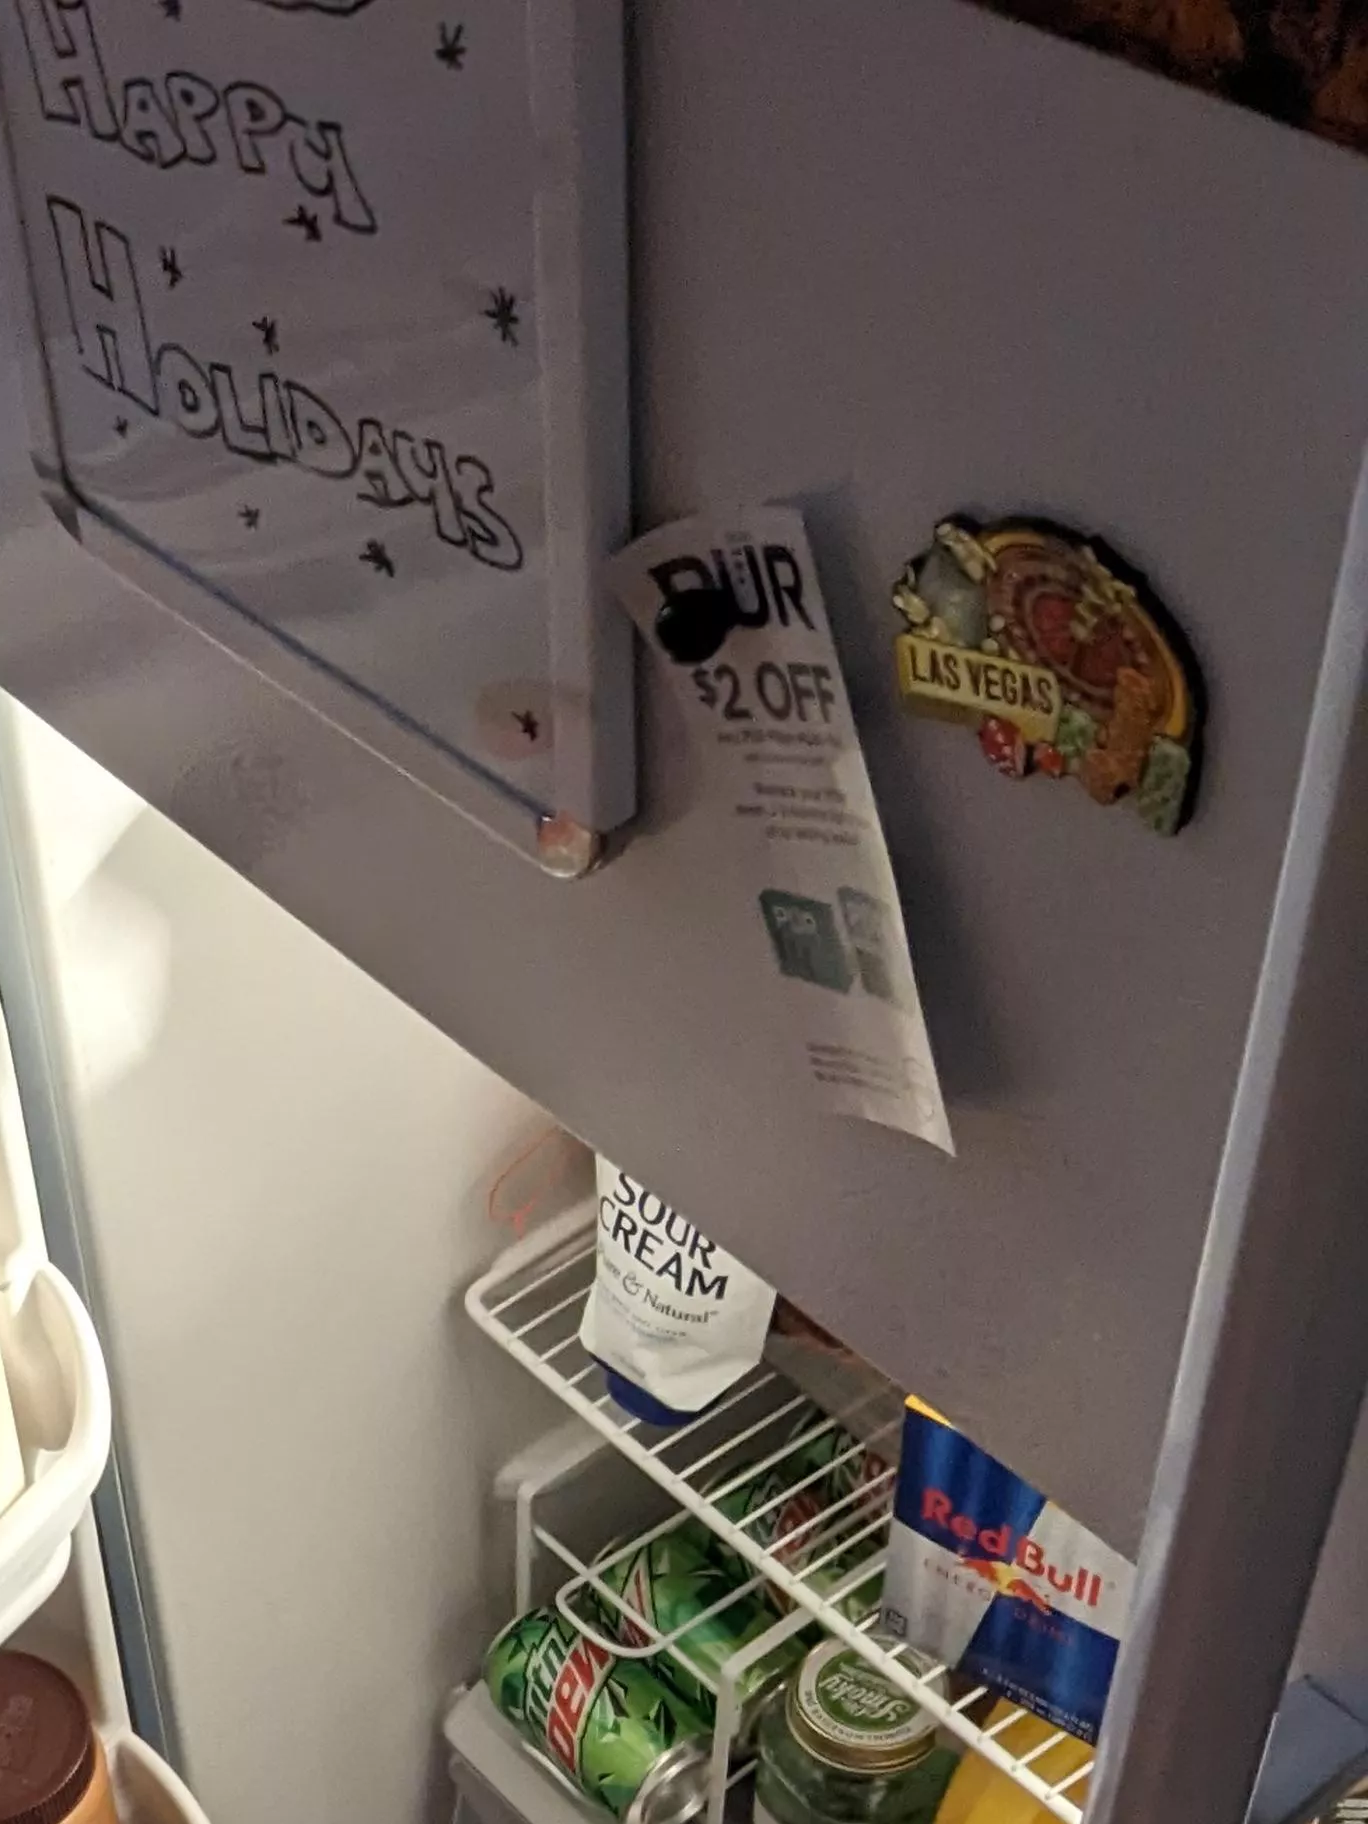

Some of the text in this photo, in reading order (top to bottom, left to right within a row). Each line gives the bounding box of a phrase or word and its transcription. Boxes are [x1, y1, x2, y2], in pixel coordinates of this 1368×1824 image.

[47, 194, 524, 571] HOLIDAYS
[691, 660, 836, 724] $2 OFF
[908, 645, 1054, 716] LAS VEGAS
[598, 1195, 730, 1301] CREAM
[613, 1172, 718, 1270] SOUR
[920, 1487, 1102, 1607] Red Bull
